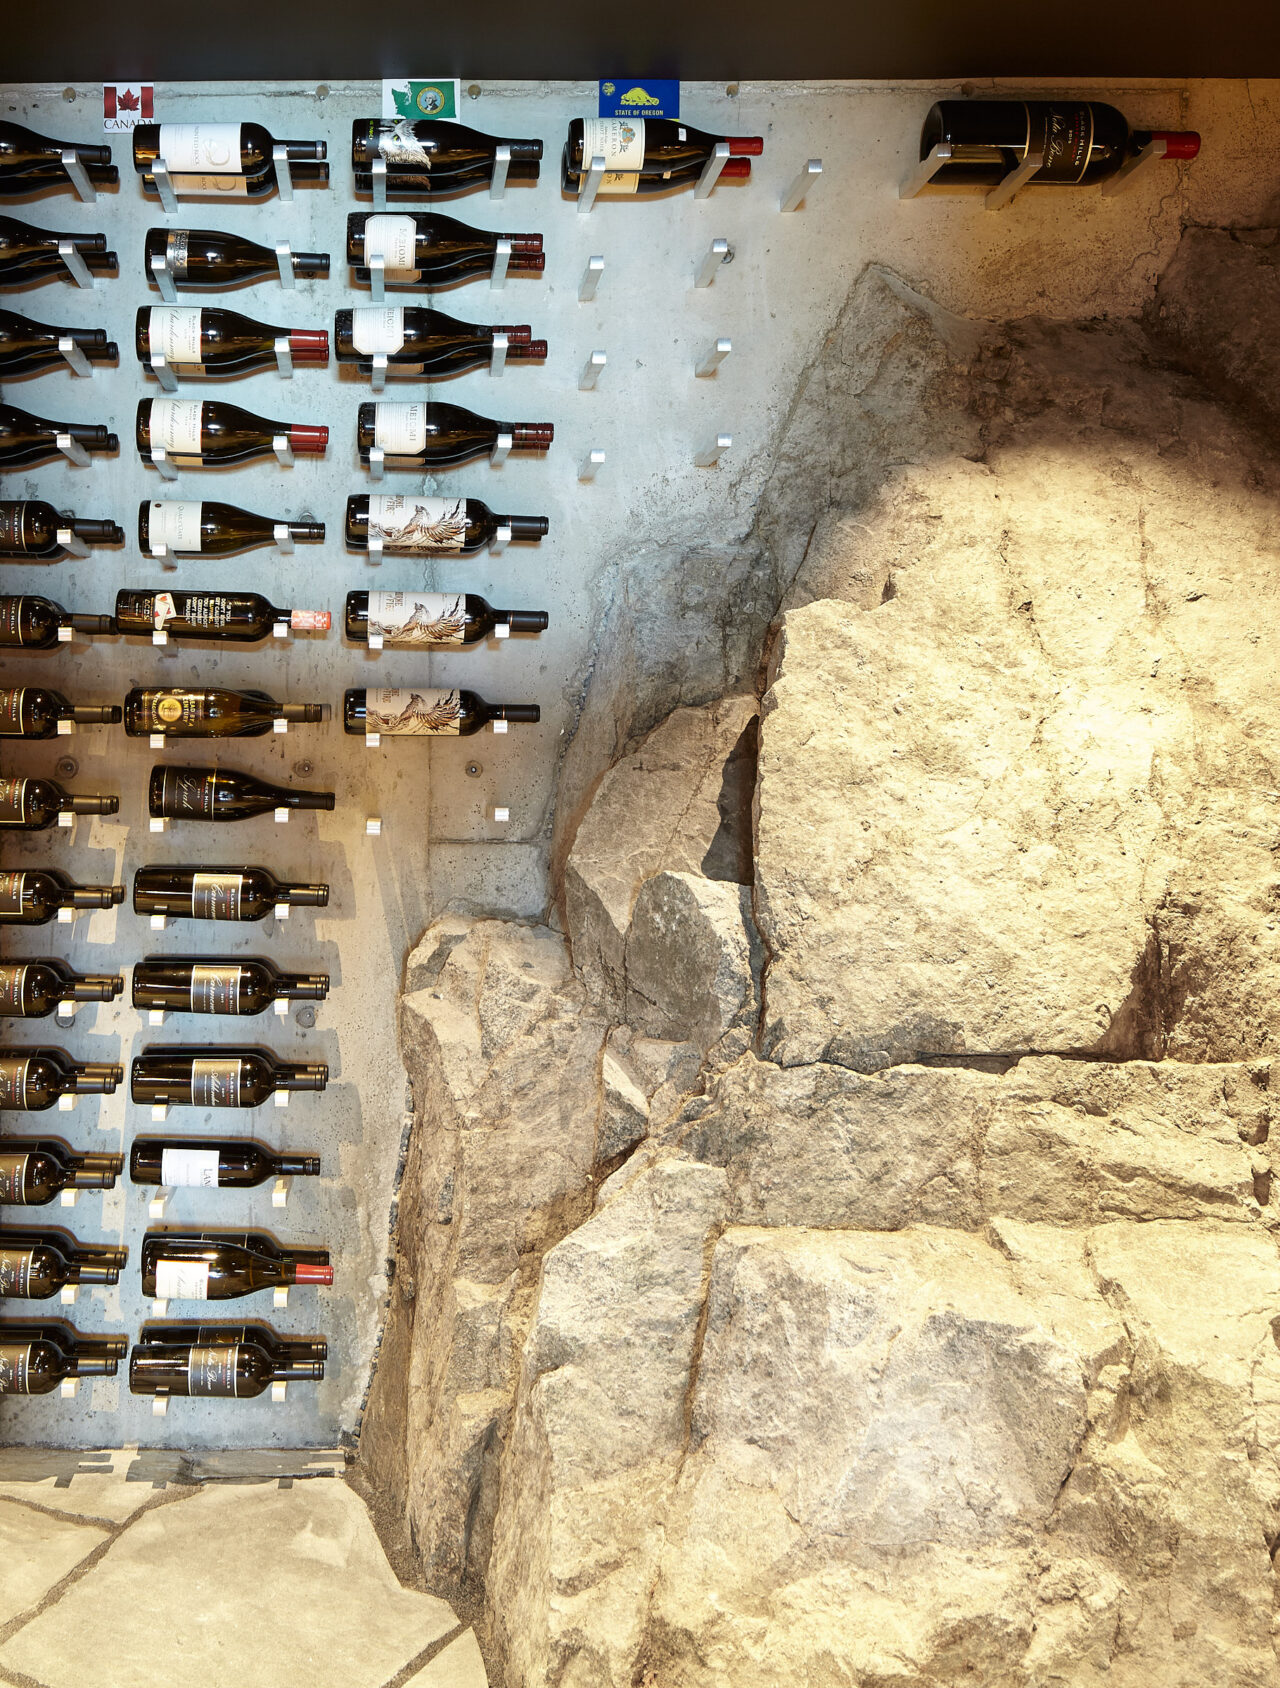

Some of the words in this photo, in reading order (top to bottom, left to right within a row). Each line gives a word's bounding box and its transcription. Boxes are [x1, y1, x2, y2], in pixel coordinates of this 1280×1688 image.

[1074, 139, 1085, 166] HILLS
[399, 228, 408, 266] MEIOMI
[168, 308, 183, 360] Chardonnay
[409, 404, 418, 442] MEIOMI
[190, 715, 197, 724] BY
[179, 774, 197, 810] Syrah
[0, 1252, 12, 1274] Nota
[207, 1348, 219, 1366] Nota
[206, 1366, 218, 1390] Bene
